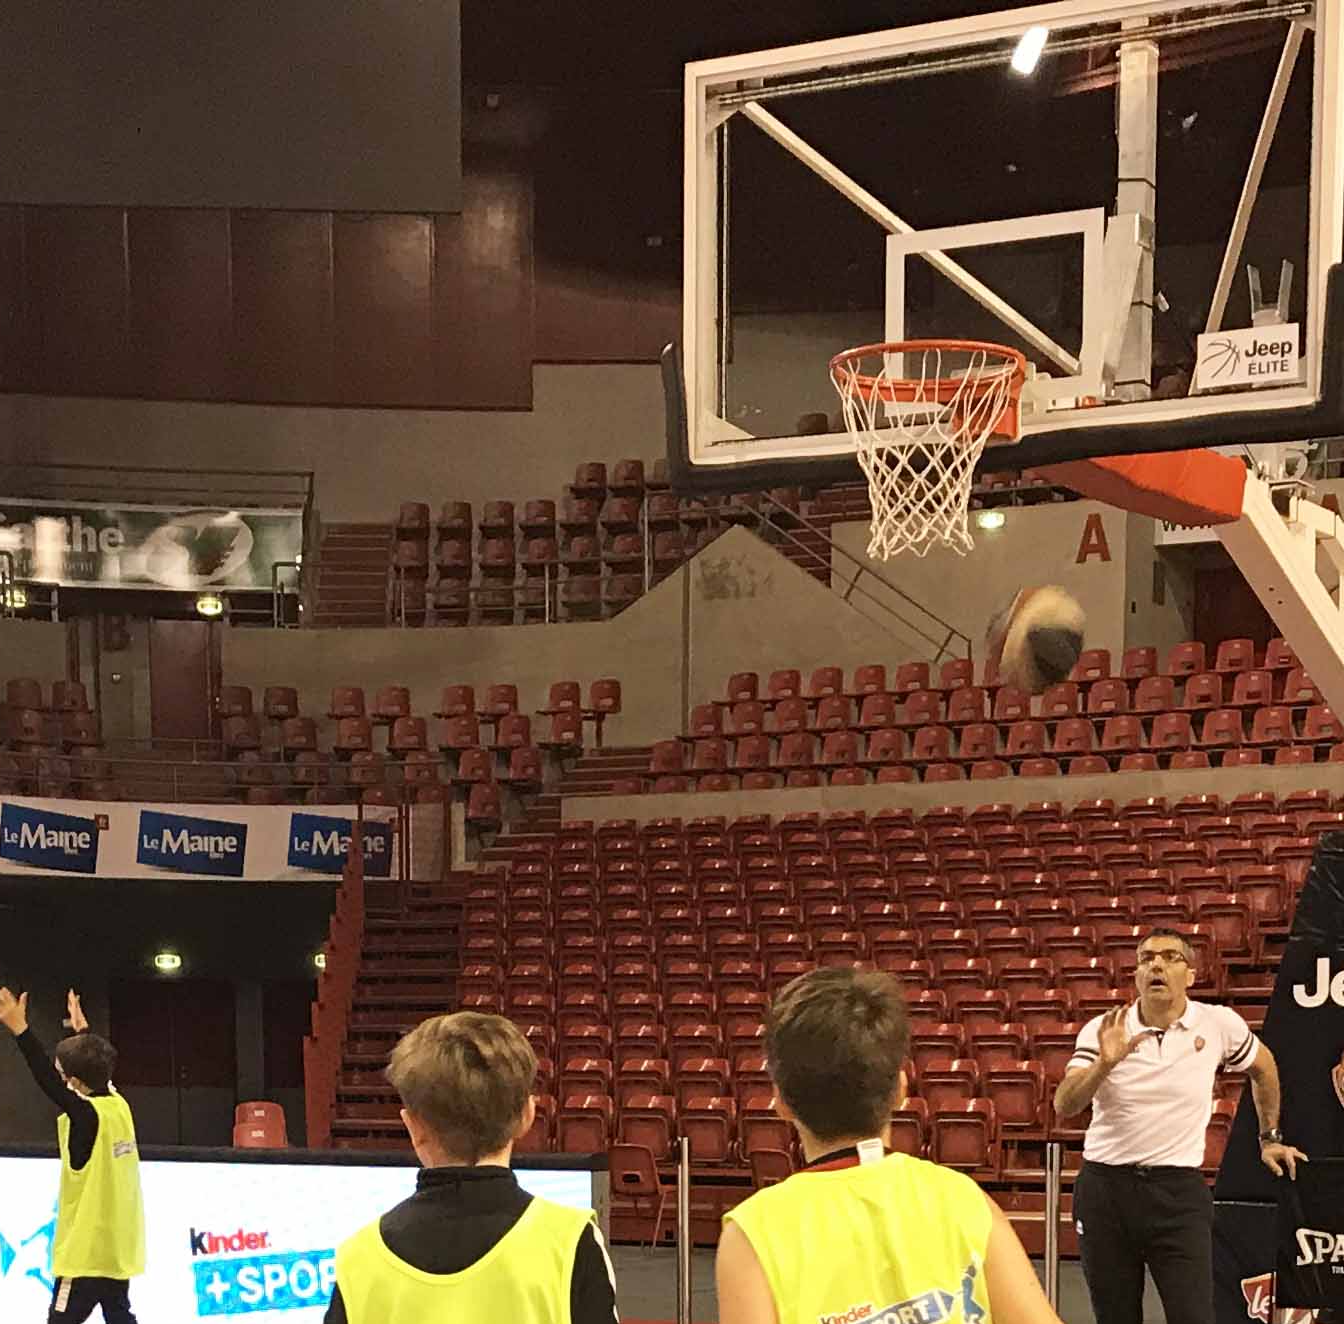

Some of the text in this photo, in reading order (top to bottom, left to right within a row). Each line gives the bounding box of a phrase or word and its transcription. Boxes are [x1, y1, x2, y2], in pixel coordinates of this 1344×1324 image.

[1244, 340, 1293, 358] Jeep
[1076, 512, 1112, 563] A
[4, 827, 19, 844] Le
[19, 822, 91, 850] Maine
[143, 828, 238, 856] Le Maine
[294, 830, 385, 857] Le Mane
